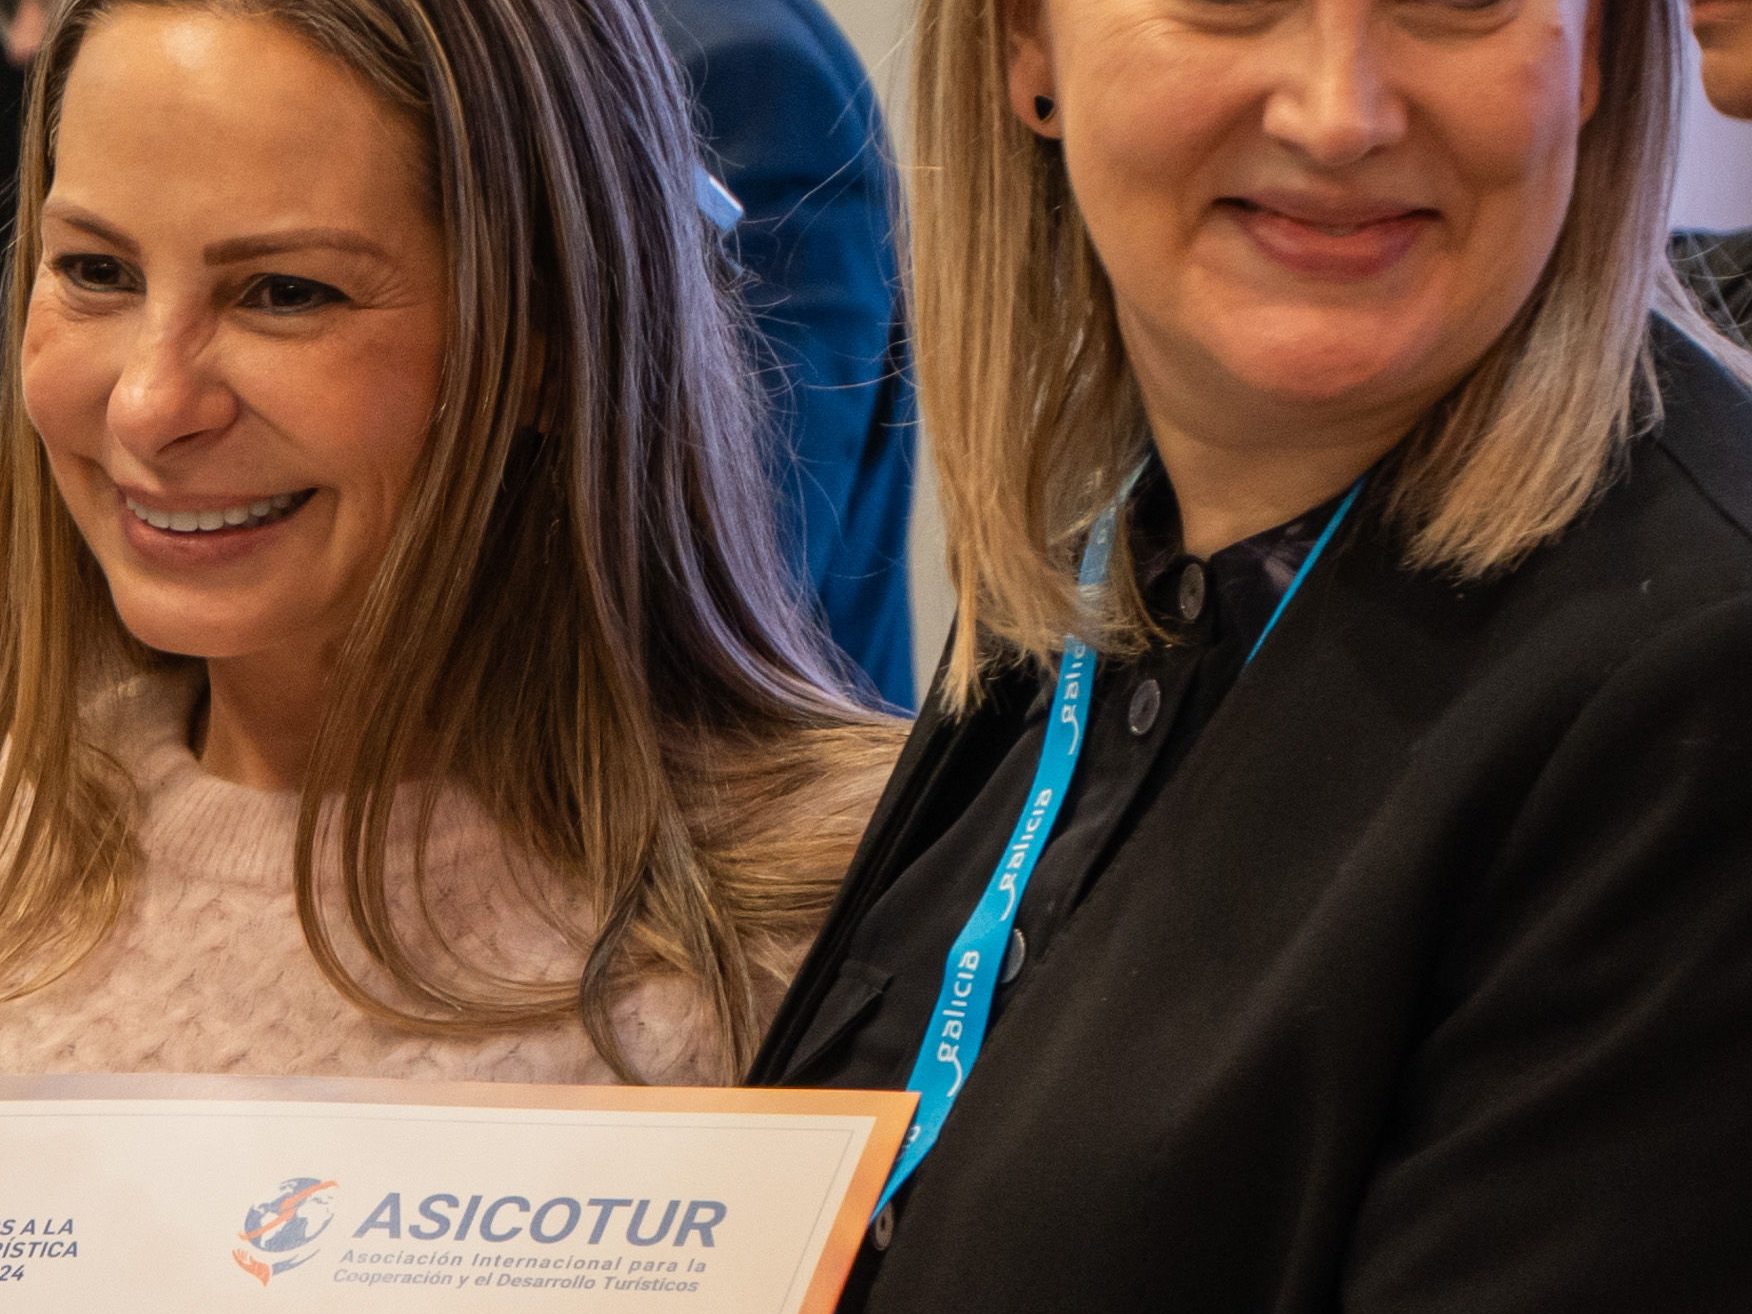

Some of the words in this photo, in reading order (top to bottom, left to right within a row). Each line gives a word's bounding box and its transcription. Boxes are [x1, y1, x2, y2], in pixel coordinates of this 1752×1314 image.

[1000, 788, 1053, 921] galicia
[937, 950, 980, 1097] galicia
[21, 1219, 36, 1235] A
[43, 1218, 74, 1235] LA
[352, 1192, 728, 1248] ASICOTUR
[332, 1269, 453, 1287] Cooperación
[457, 1276, 471, 1289] y
[475, 1273, 493, 1287] el
[496, 1274, 597, 1289] Desarrollo
[603, 1276, 700, 1292] Turísticos
[340, 1249, 463, 1267] Asociación
[473, 1253, 622, 1271] Internacional
[628, 1259, 680, 1275] para
[687, 1259, 707, 1273] la
